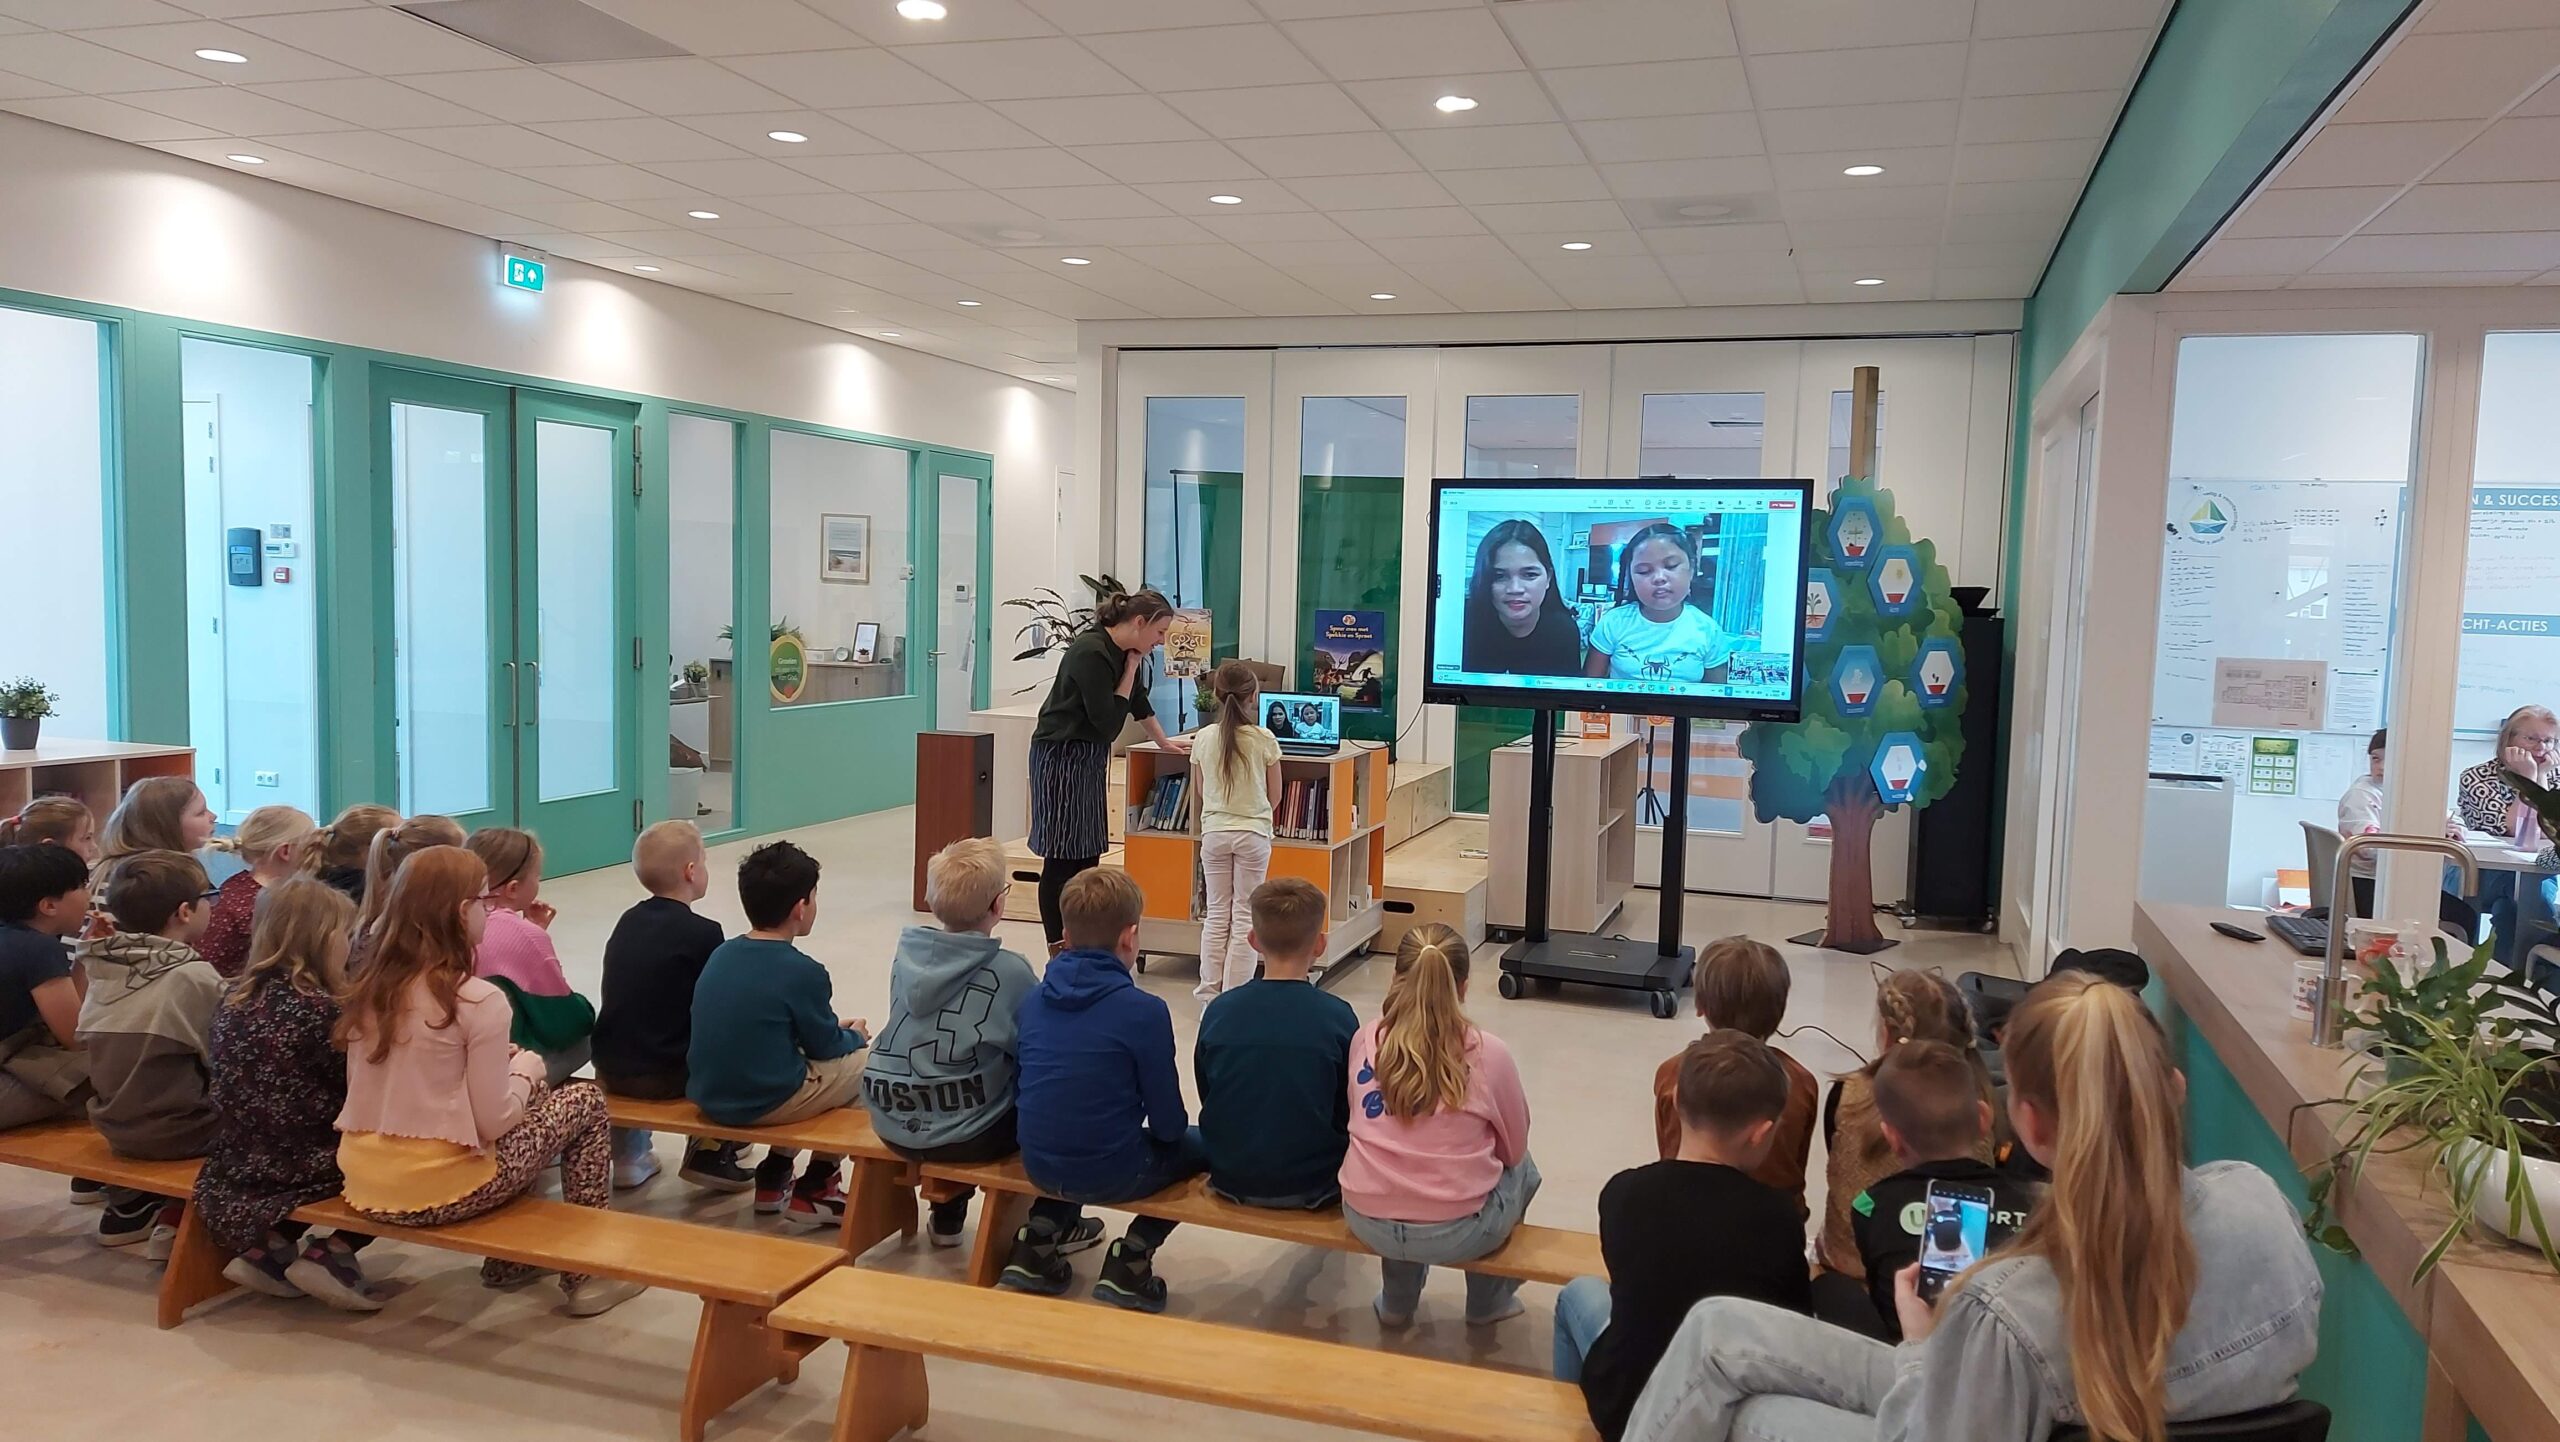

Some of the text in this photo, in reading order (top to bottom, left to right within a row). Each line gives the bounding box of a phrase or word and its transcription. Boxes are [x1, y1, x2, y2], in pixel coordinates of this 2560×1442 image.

[2483, 494, 2494, 506] &
[2498, 494, 2560, 507] SUCCES
[2462, 617, 2548, 632] CHT-ACTIES
